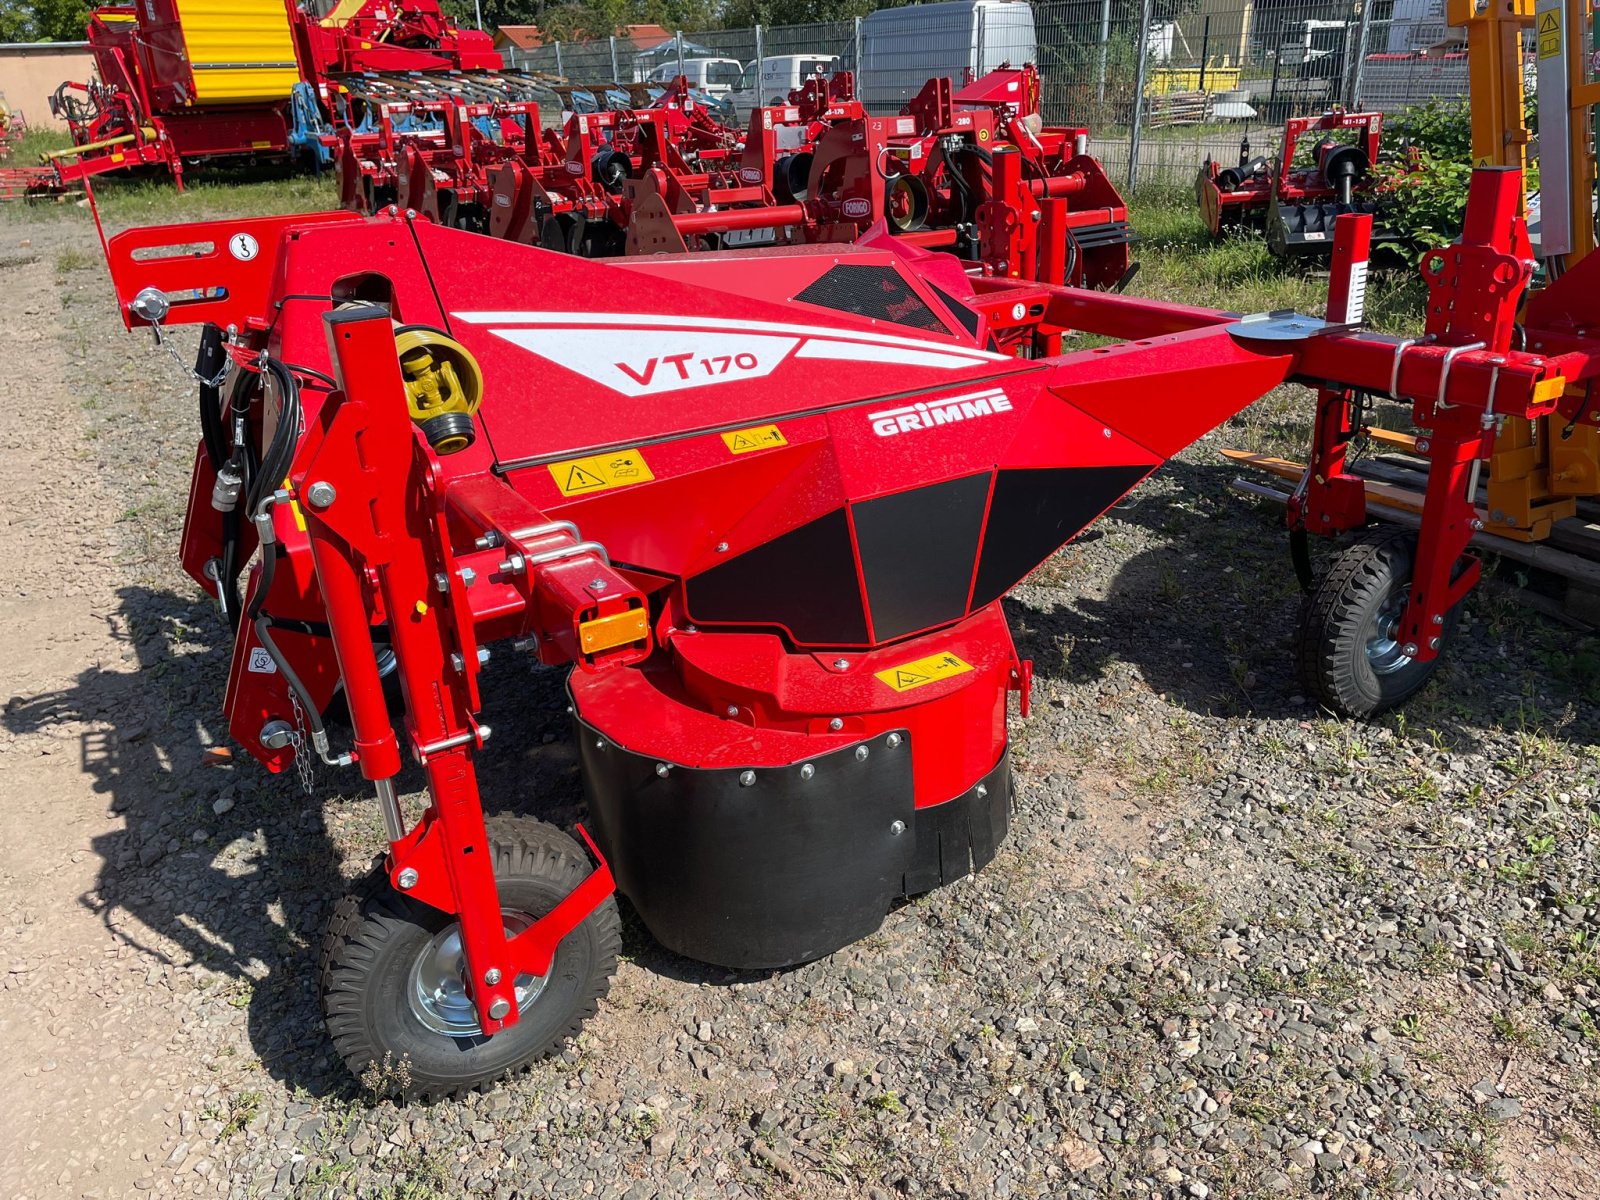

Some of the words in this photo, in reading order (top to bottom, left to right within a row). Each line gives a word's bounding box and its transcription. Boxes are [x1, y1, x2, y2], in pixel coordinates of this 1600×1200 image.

[872, 122, 882, 131] 23
[846, 202, 868, 213] FORIGO
[614, 352, 695, 386] VT
[700, 353, 758, 375] 170
[868, 388, 1013, 437] GRIMME
